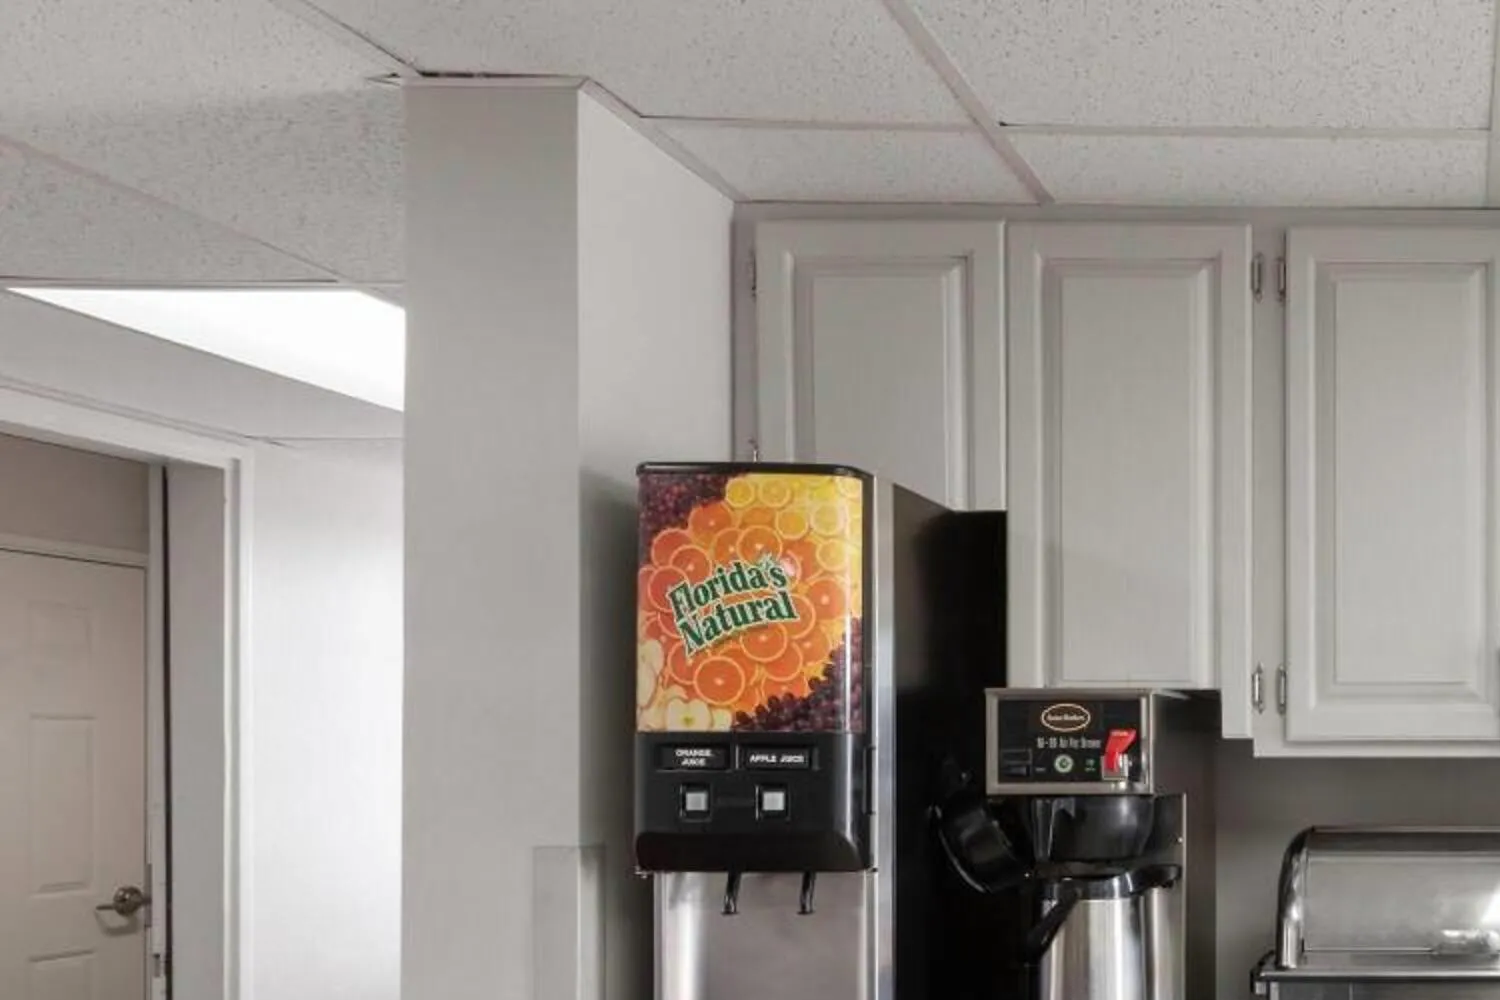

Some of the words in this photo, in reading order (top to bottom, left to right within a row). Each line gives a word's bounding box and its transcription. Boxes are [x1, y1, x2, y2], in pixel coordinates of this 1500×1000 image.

[669, 557, 788, 620] Florida's
[679, 590, 798, 656] Natural
[749, 754, 777, 763] APPLE
